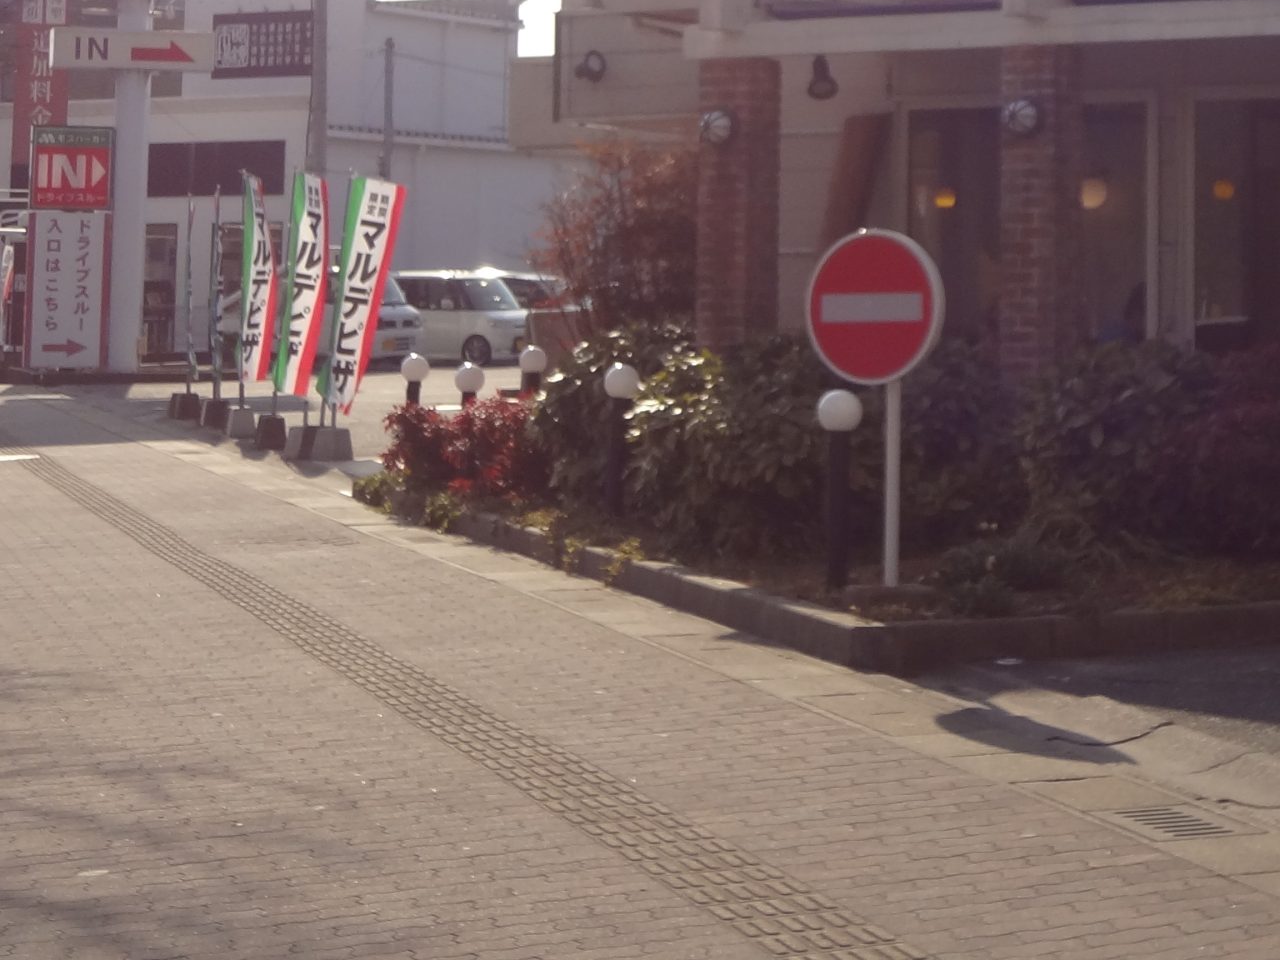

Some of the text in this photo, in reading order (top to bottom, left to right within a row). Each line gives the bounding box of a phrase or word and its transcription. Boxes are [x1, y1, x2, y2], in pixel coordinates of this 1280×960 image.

[75, 37, 109, 60] IN
[37, 154, 87, 189] IN
[45, 218, 63, 331] 入口はこちら
[73, 219, 91, 331] ドライブスルー
[332, 219, 387, 393] マルデピザ
